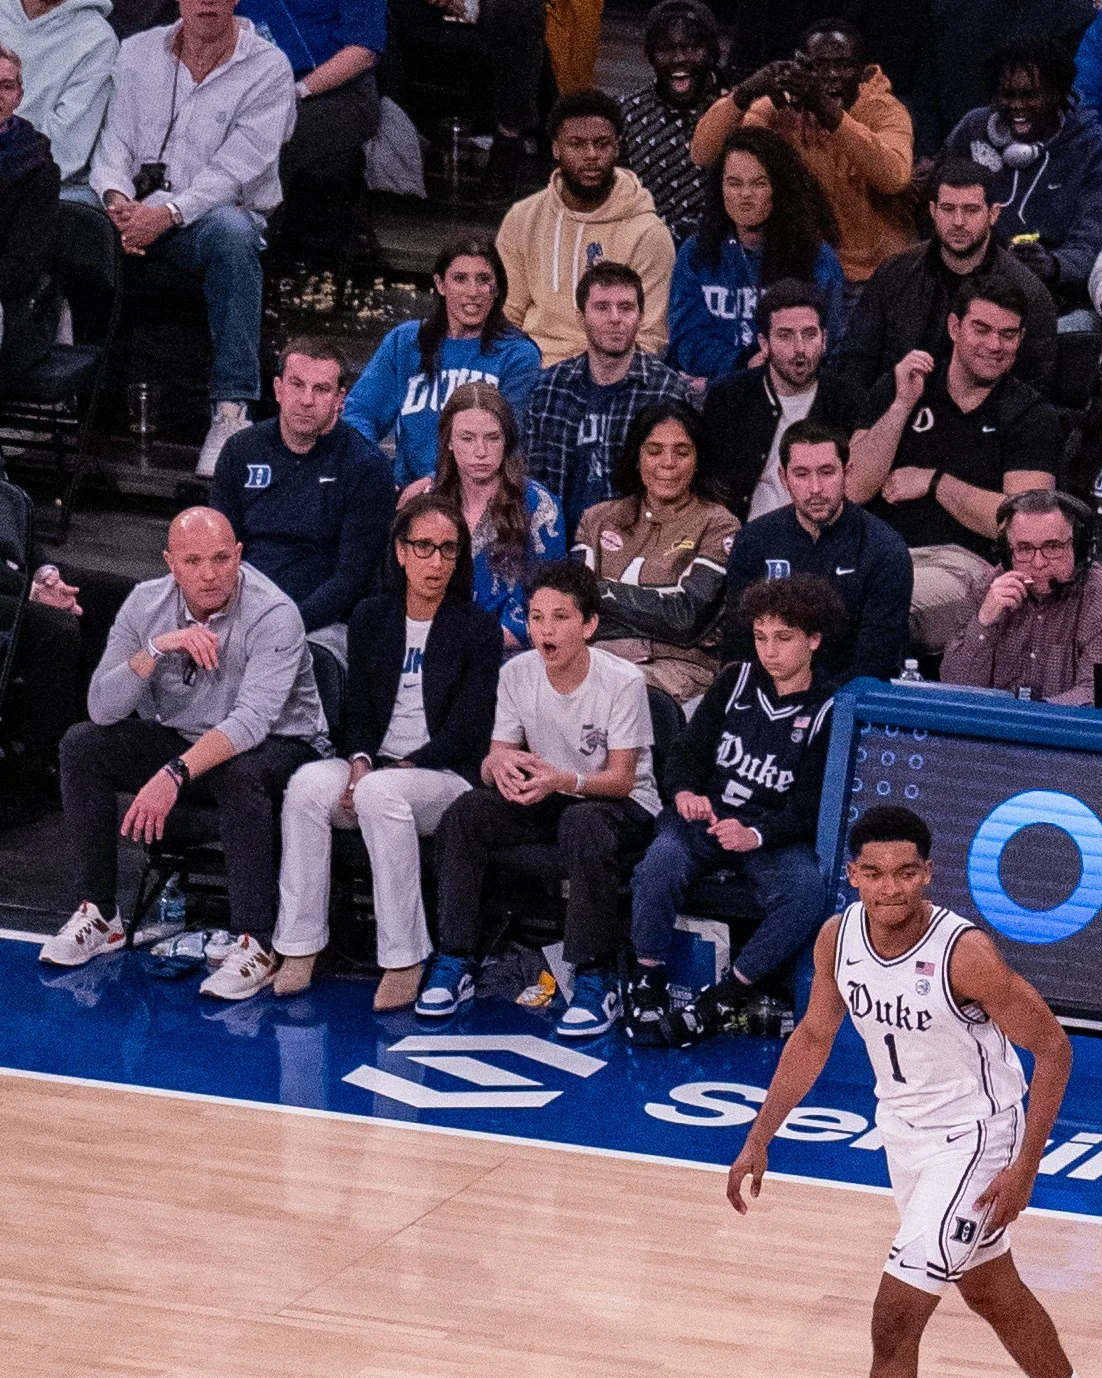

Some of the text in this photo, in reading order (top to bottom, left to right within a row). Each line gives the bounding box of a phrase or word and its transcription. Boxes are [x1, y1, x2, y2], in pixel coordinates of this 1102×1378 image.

[716, 731, 795, 792] Duke
[847, 980, 933, 1032] Duke
[883, 1032, 907, 1084] 1
